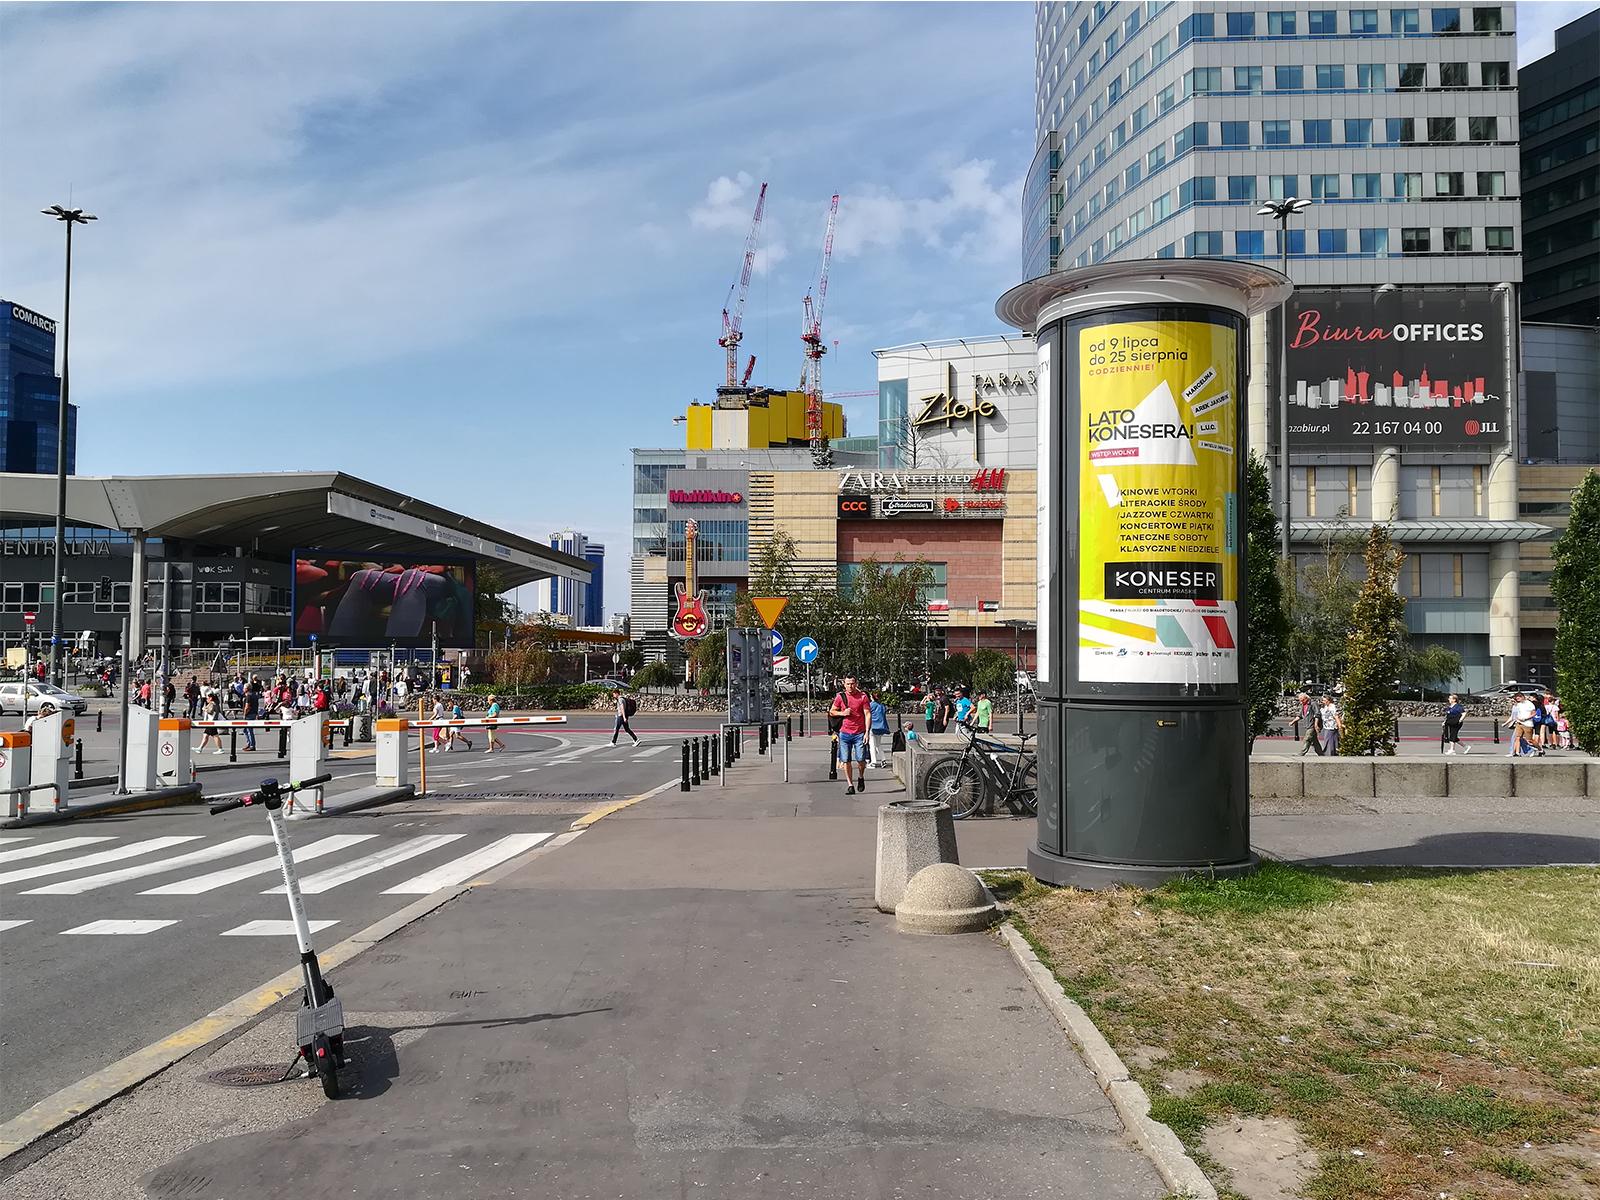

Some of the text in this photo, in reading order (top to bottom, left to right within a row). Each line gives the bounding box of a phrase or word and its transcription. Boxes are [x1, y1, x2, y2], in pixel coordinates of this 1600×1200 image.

[12, 306, 56, 334] COMARCH
[1289, 309, 1484, 349] Biura OFFICES
[1089, 336, 1159, 353] od 9 lipca
[1089, 348, 1188, 366] do 25 sierpnia
[1088, 364, 1155, 376] CODZIENNIE!
[1185, 371, 1214, 398] MARCELINA
[1195, 403, 1210, 413] AREK
[1089, 409, 1135, 427] LATO
[1089, 424, 1194, 443] KONESERA!
[1352, 421, 1442, 434] 22 167 04 00
[1479, 422, 1499, 433] JLL
[1112, 448, 1136, 457] WOLNY
[838, 471, 904, 490] ZARA
[903, 474, 971, 483] RESERVED
[1162, 488, 1198, 496] WTORKI
[841, 501, 867, 511] CCC
[1120, 498, 1207, 507] LITERACKIE ŚRODY
[1170, 511, 1214, 519] CZWARTKI
[1189, 523, 1214, 531] PIĄTKI
[1173, 533, 1208, 541] SOBOTY
[0, 540, 111, 555] ENTRLNA
[1179, 545, 1219, 553] NIEDZIELE
[1115, 571, 1216, 587] KONESER
